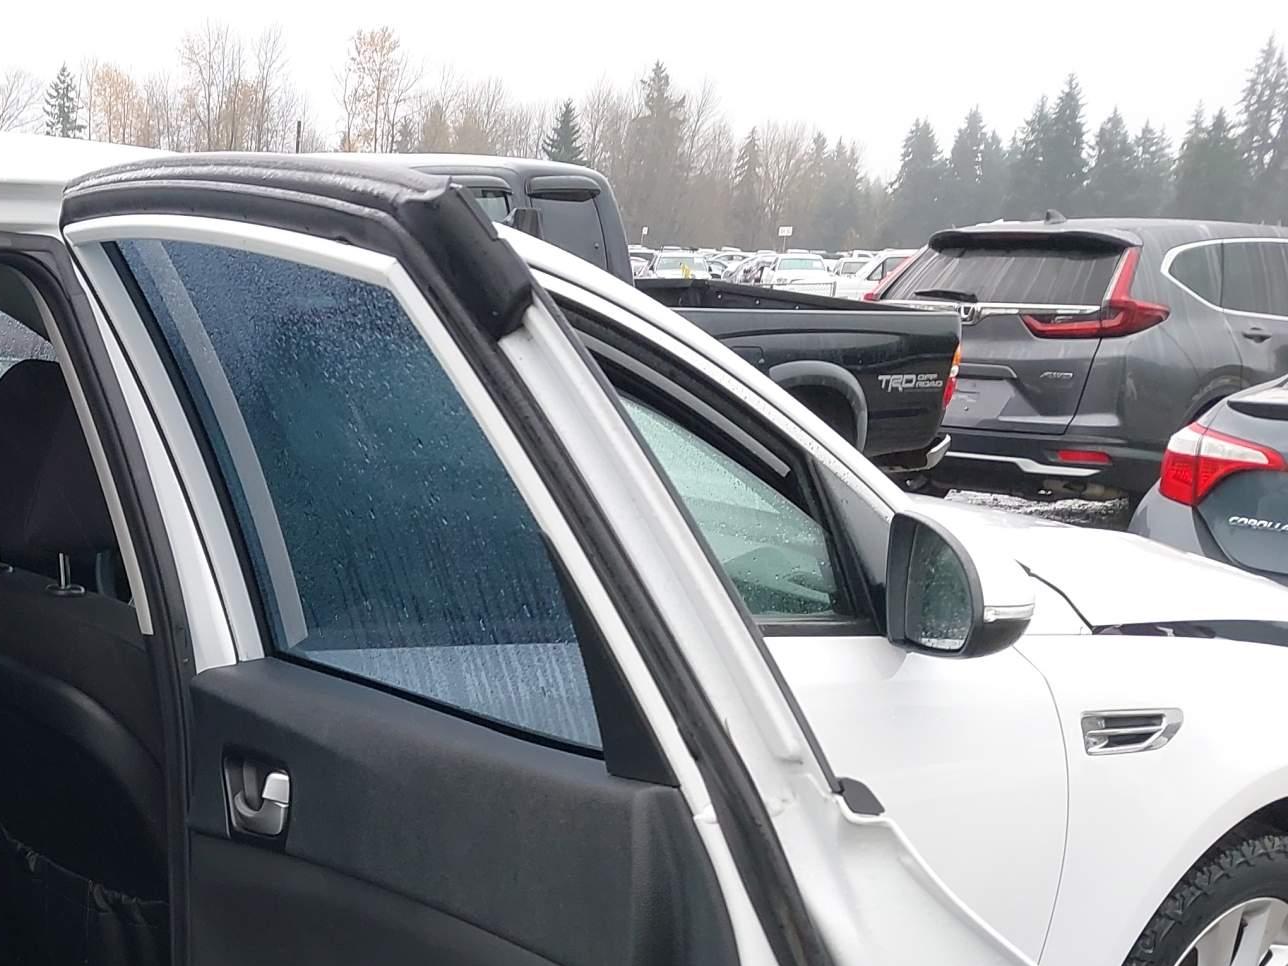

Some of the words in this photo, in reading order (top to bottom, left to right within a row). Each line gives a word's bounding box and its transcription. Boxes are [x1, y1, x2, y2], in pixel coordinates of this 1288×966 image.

[878, 374, 916, 392] TRD
[917, 373, 938, 381] OFF
[916, 380, 943, 388] ROAD
